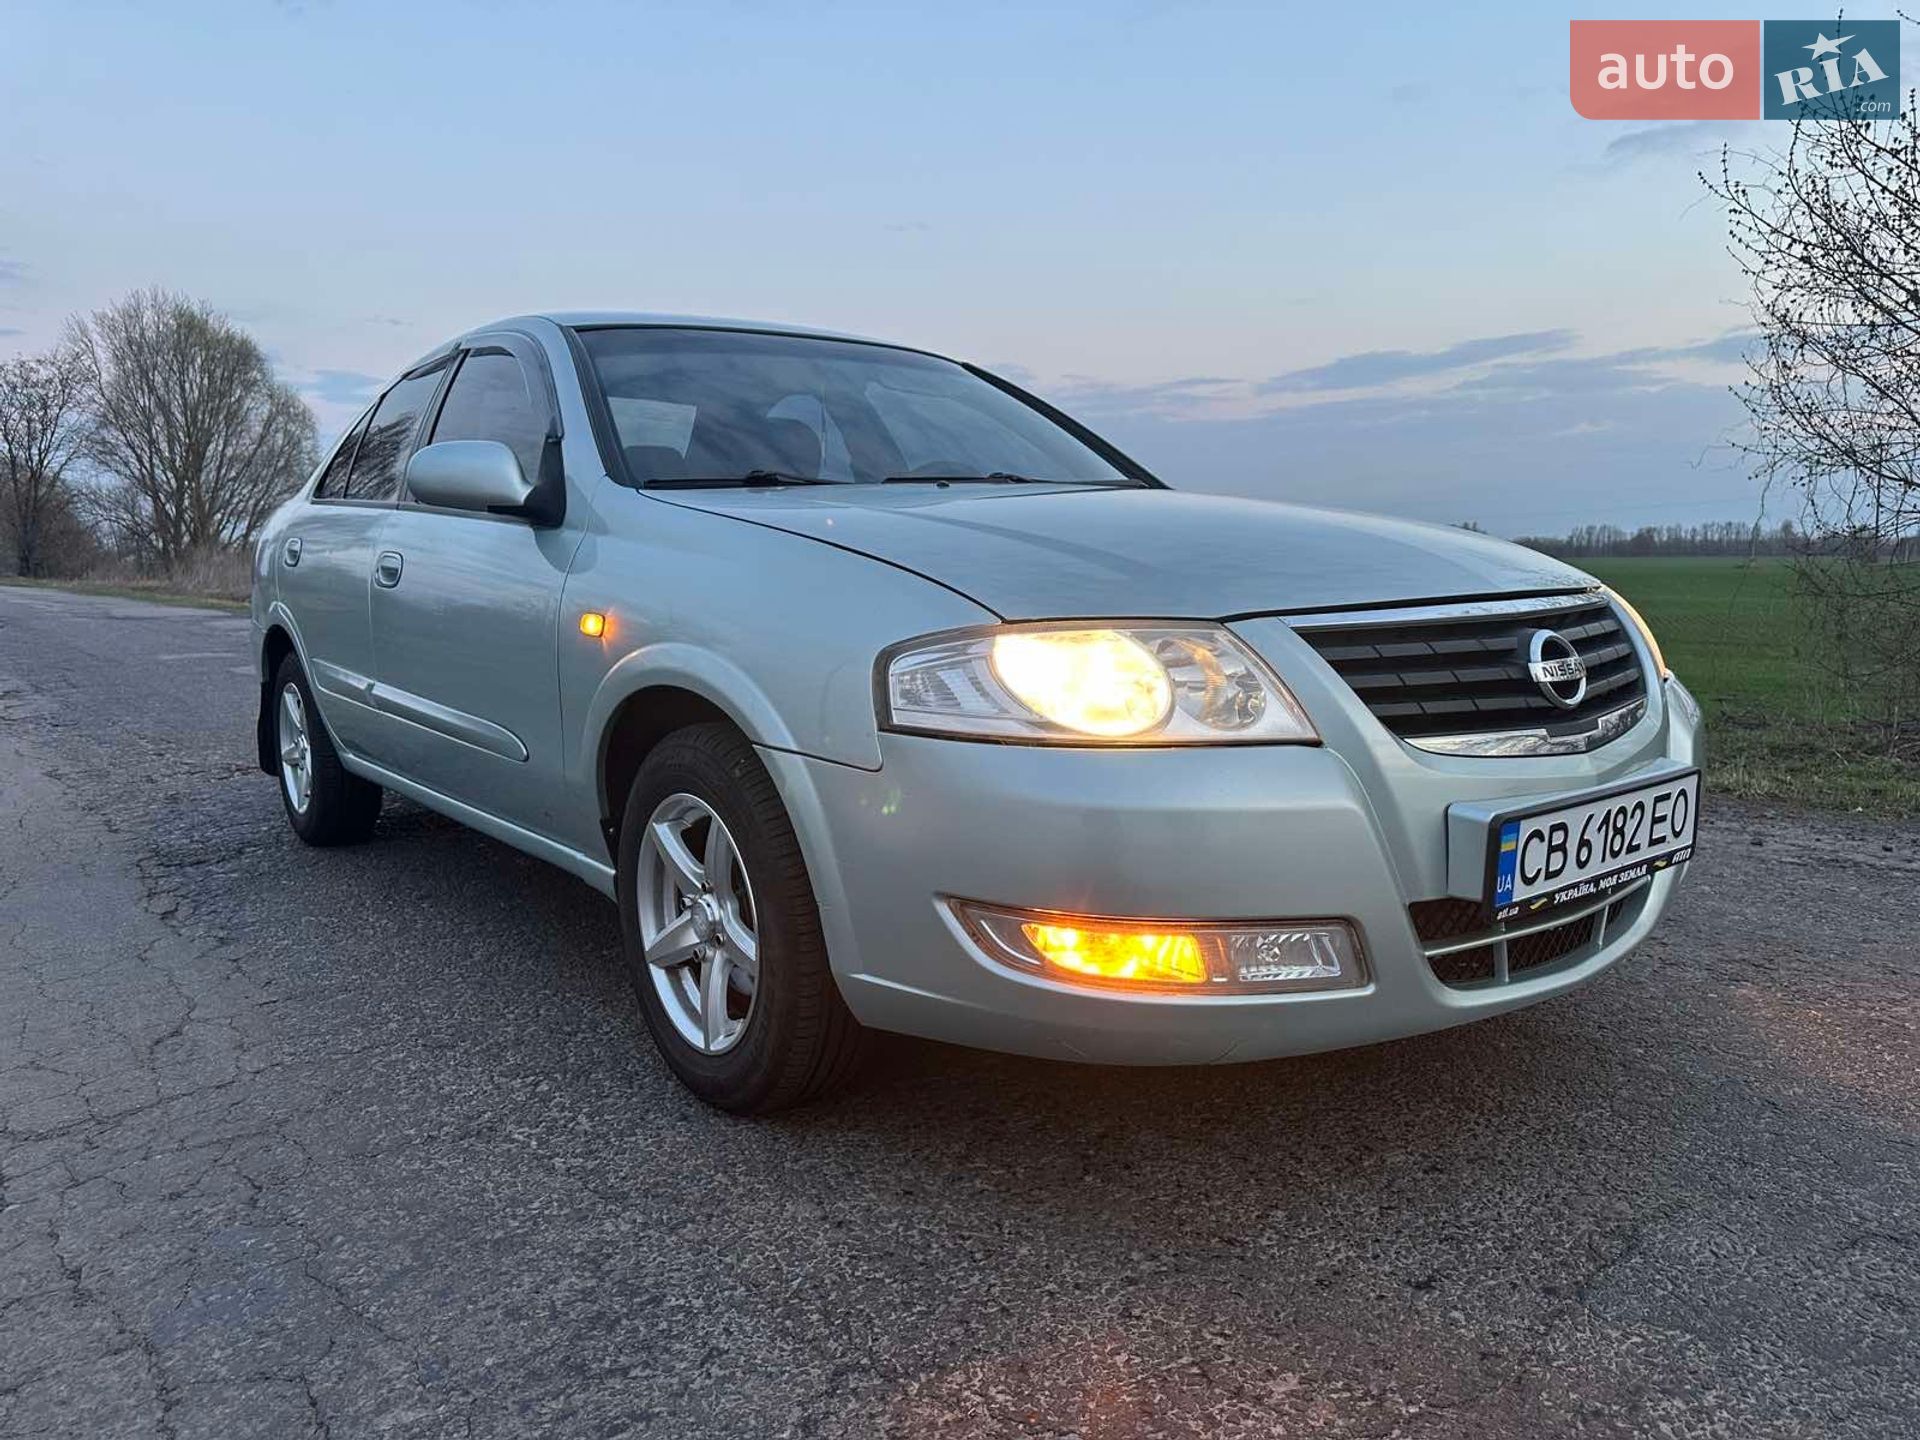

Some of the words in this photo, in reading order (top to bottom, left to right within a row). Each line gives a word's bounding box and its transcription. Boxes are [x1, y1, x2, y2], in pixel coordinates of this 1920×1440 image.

[1541, 660, 1584, 679] NISSAN
[1575, 800, 1646, 870] 6182
[1496, 873, 1513, 894] UA
